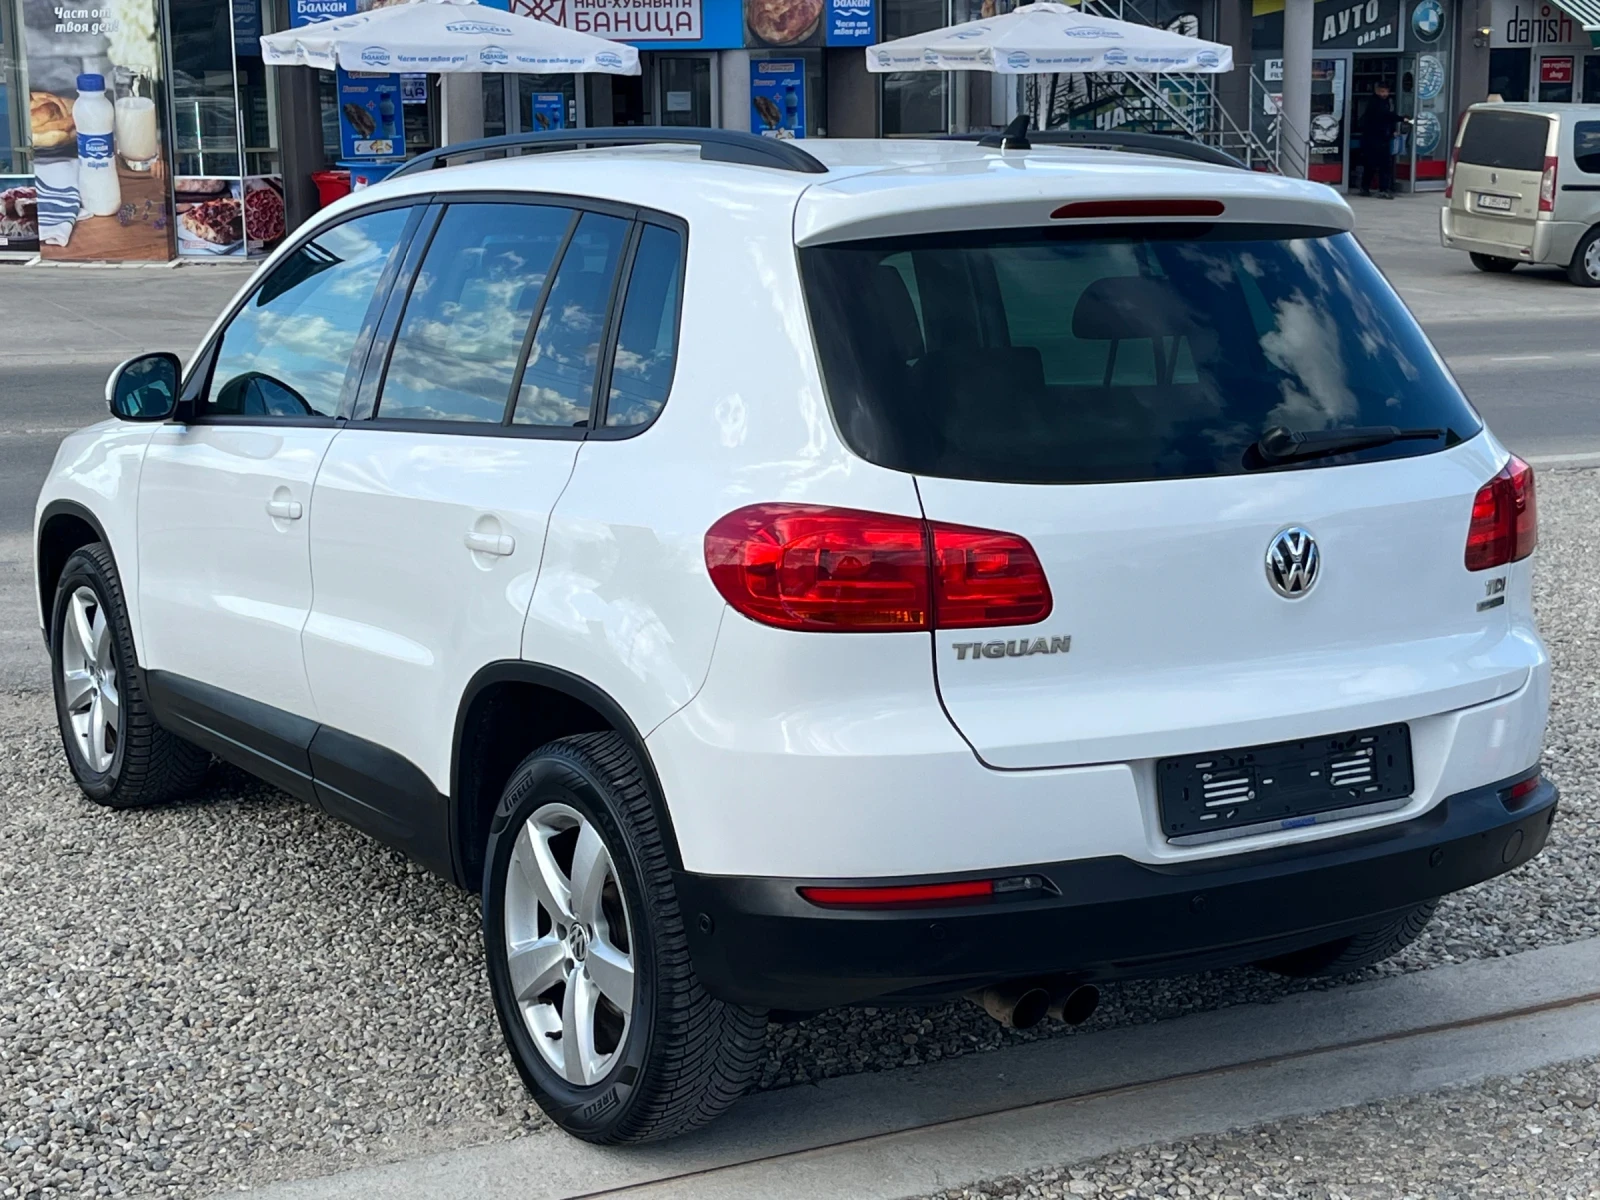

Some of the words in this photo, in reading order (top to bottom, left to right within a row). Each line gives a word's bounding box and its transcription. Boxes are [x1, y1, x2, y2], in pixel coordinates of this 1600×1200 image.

[54, 7, 89, 19] Част
[91, 9, 111, 18] от
[297, 0, 347, 13] Балкан
[55, 21, 89, 33] твоя
[575, 11, 692, 36] БАНИЦА
[1322, 0, 1379, 42] АУТО
[1507, 5, 1572, 43] danish
[1357, 24, 1392, 46] ОЙЛ-КА
[361, 52, 391, 61] Балкан
[480, 52, 509, 60] Балкан
[1485, 576, 1506, 596] TDI
[952, 635, 1071, 661] TIGUAN
[503, 769, 534, 812] PIRELLI
